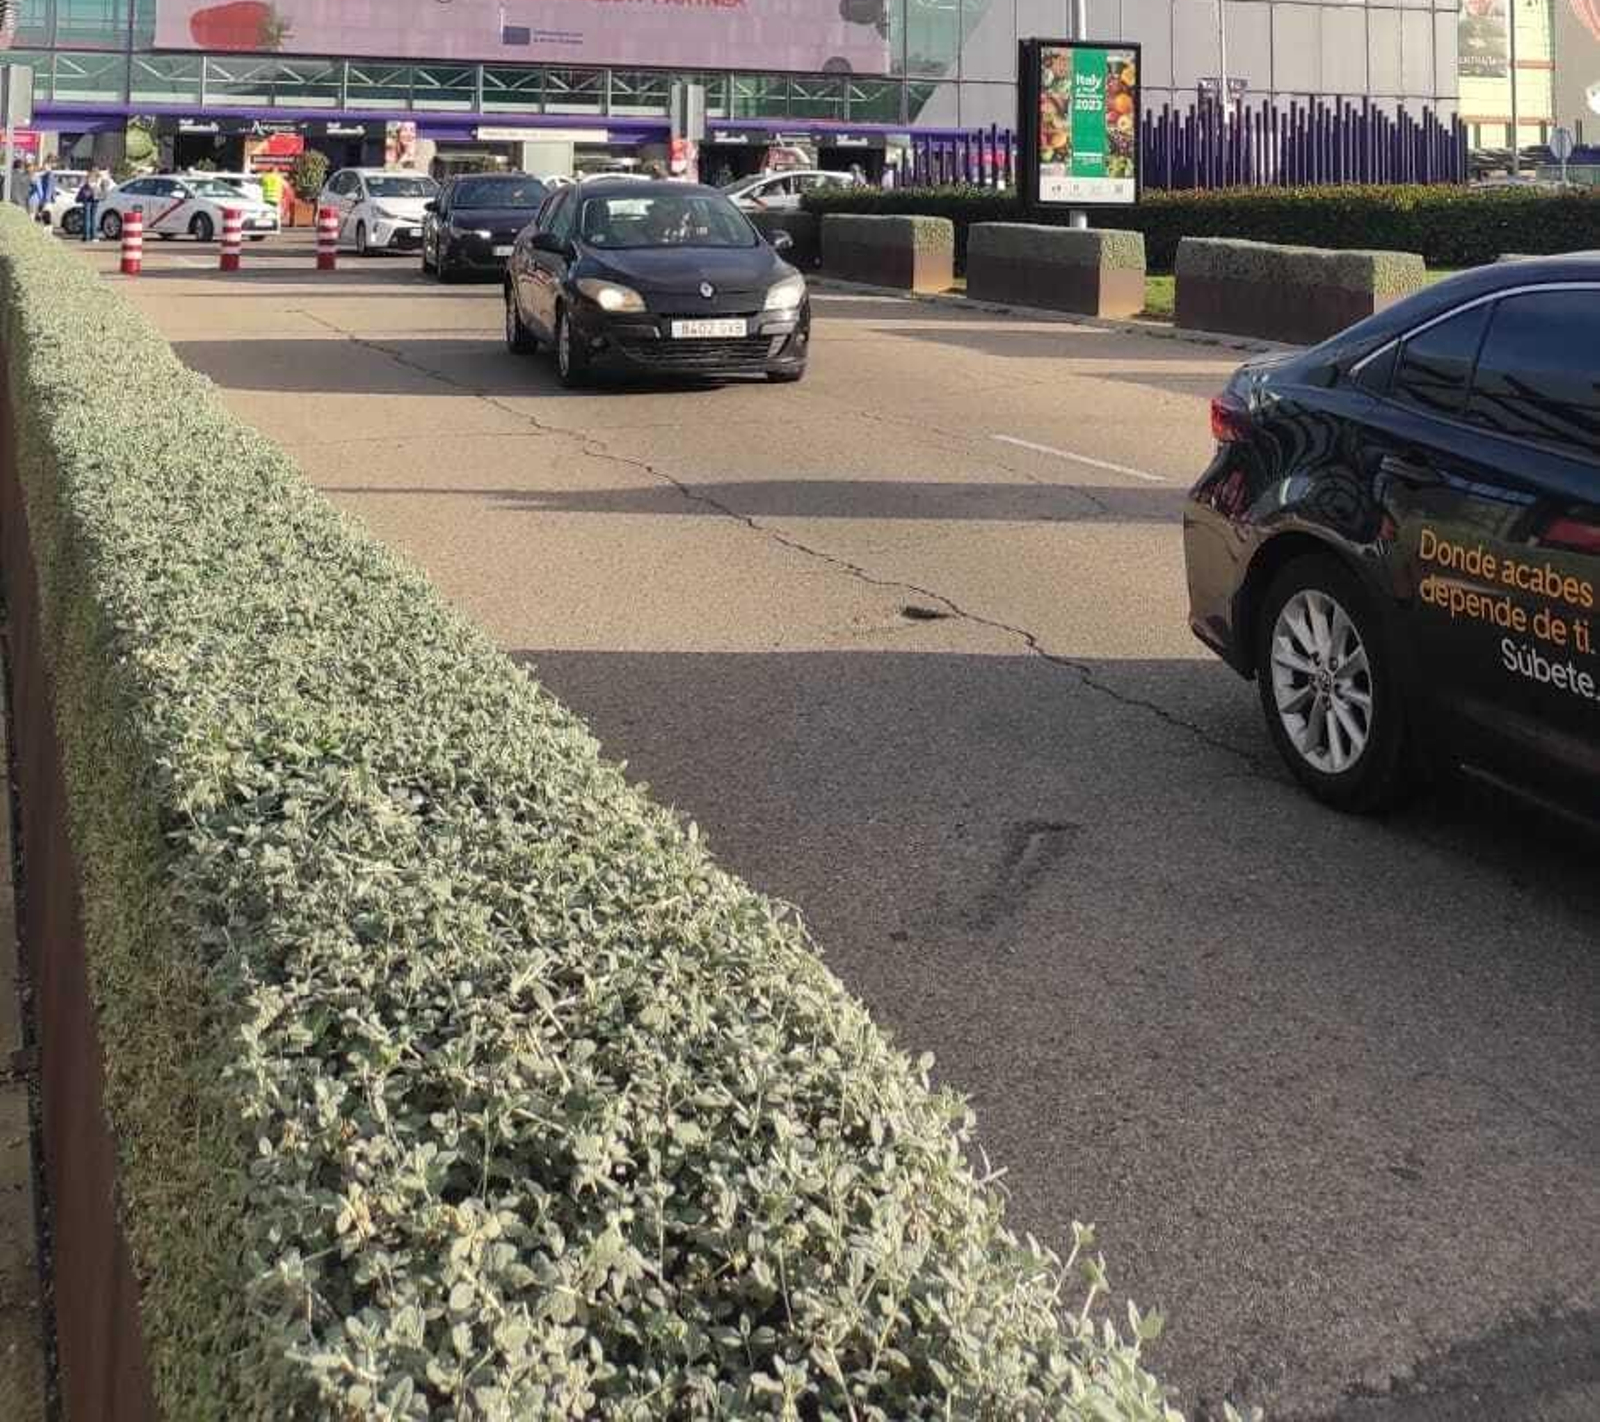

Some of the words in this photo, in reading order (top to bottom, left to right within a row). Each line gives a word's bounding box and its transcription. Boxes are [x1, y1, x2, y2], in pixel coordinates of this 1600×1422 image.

[1419, 529, 1496, 579] Donde
[1502, 559, 1594, 608] acabes
[1419, 573, 1527, 632] depende
[1533, 609, 1567, 645] de
